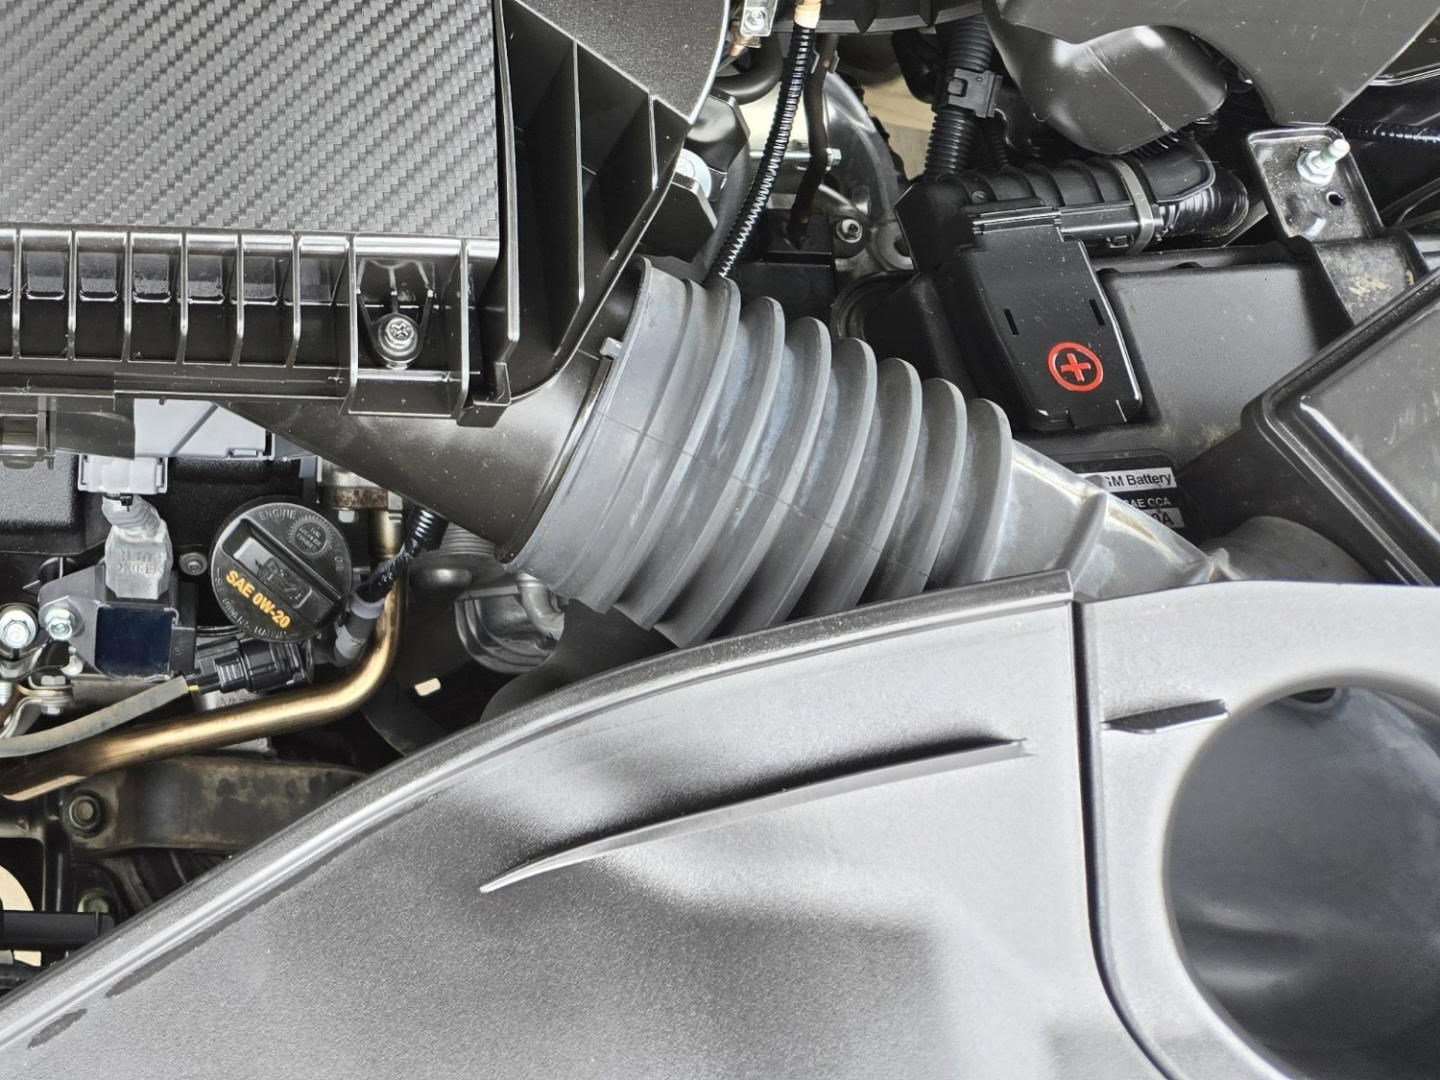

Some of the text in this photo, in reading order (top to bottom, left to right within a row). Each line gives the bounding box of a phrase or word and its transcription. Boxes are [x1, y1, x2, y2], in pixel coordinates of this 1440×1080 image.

[1126, 473, 1172, 486] Battery
[1147, 497, 1172, 507] CCA
[258, 509, 297, 520] ENGINE
[225, 569, 292, 629] SAE 0W-20
